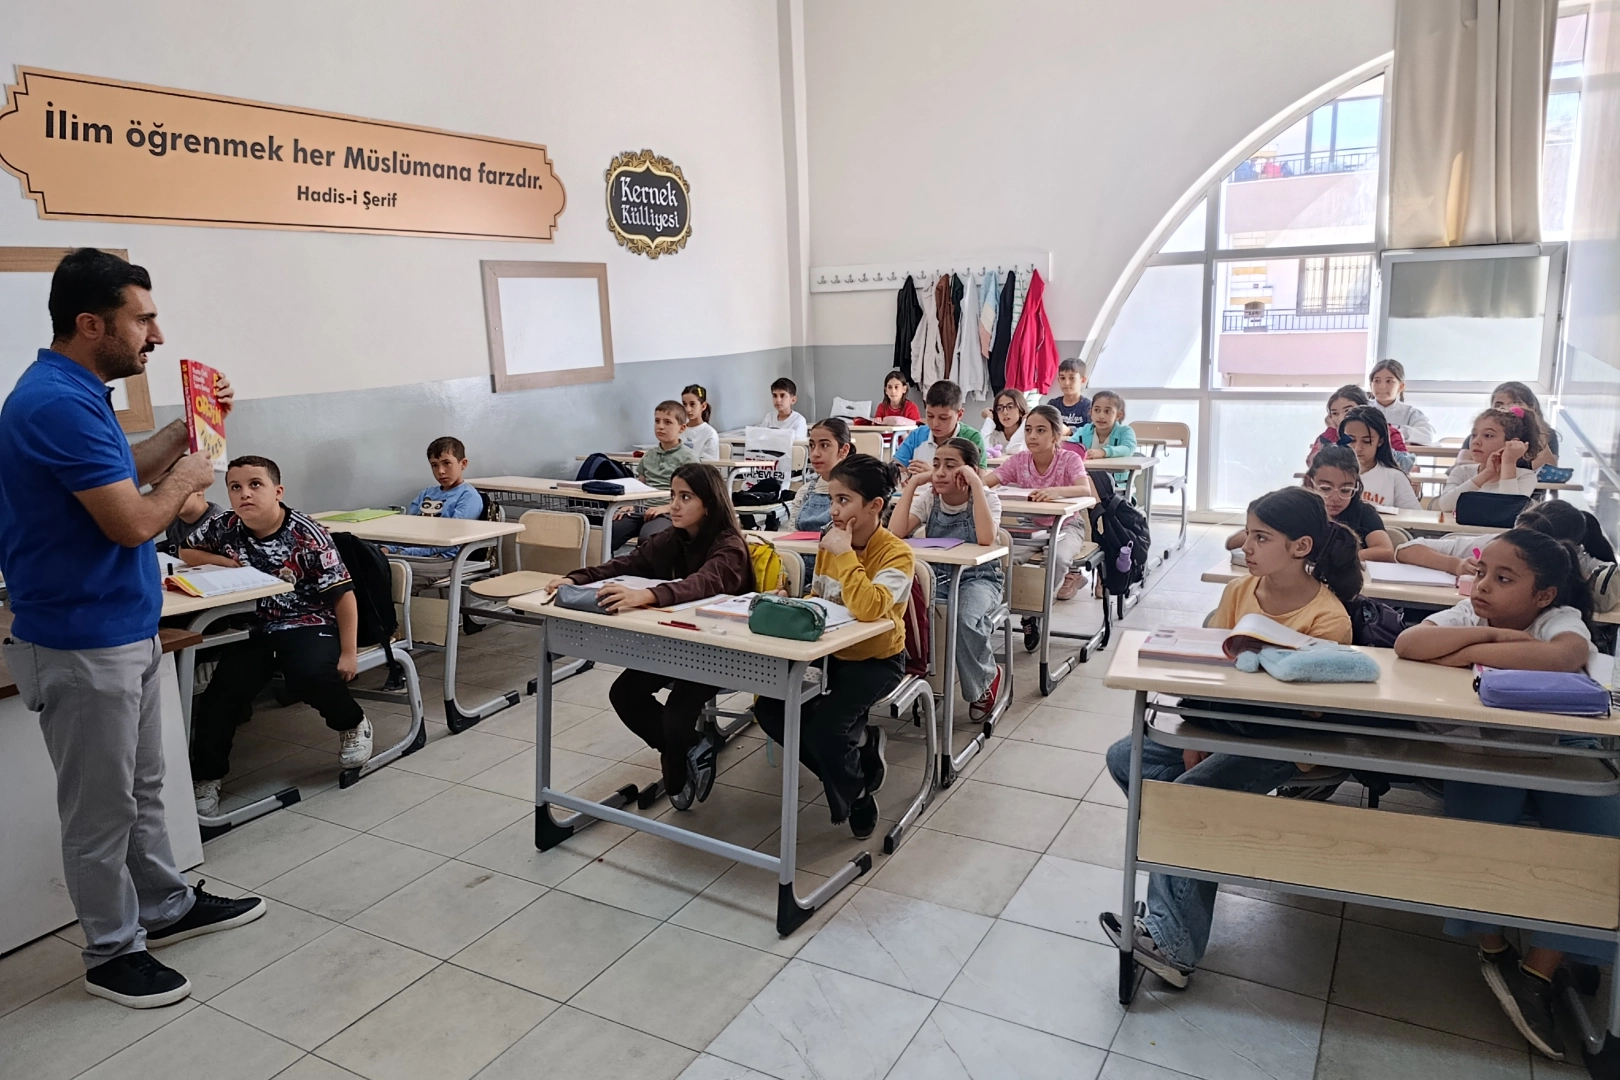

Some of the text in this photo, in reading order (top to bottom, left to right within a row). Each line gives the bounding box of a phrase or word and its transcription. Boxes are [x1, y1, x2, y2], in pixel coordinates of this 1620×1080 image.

[45, 101, 543, 190] İlim öğrenmek her Müslümana farzdır.
[297, 185, 398, 210] Hadis-i Şerif
[620, 176, 678, 207] Kernek
[621, 204, 680, 232] Külliyesi
